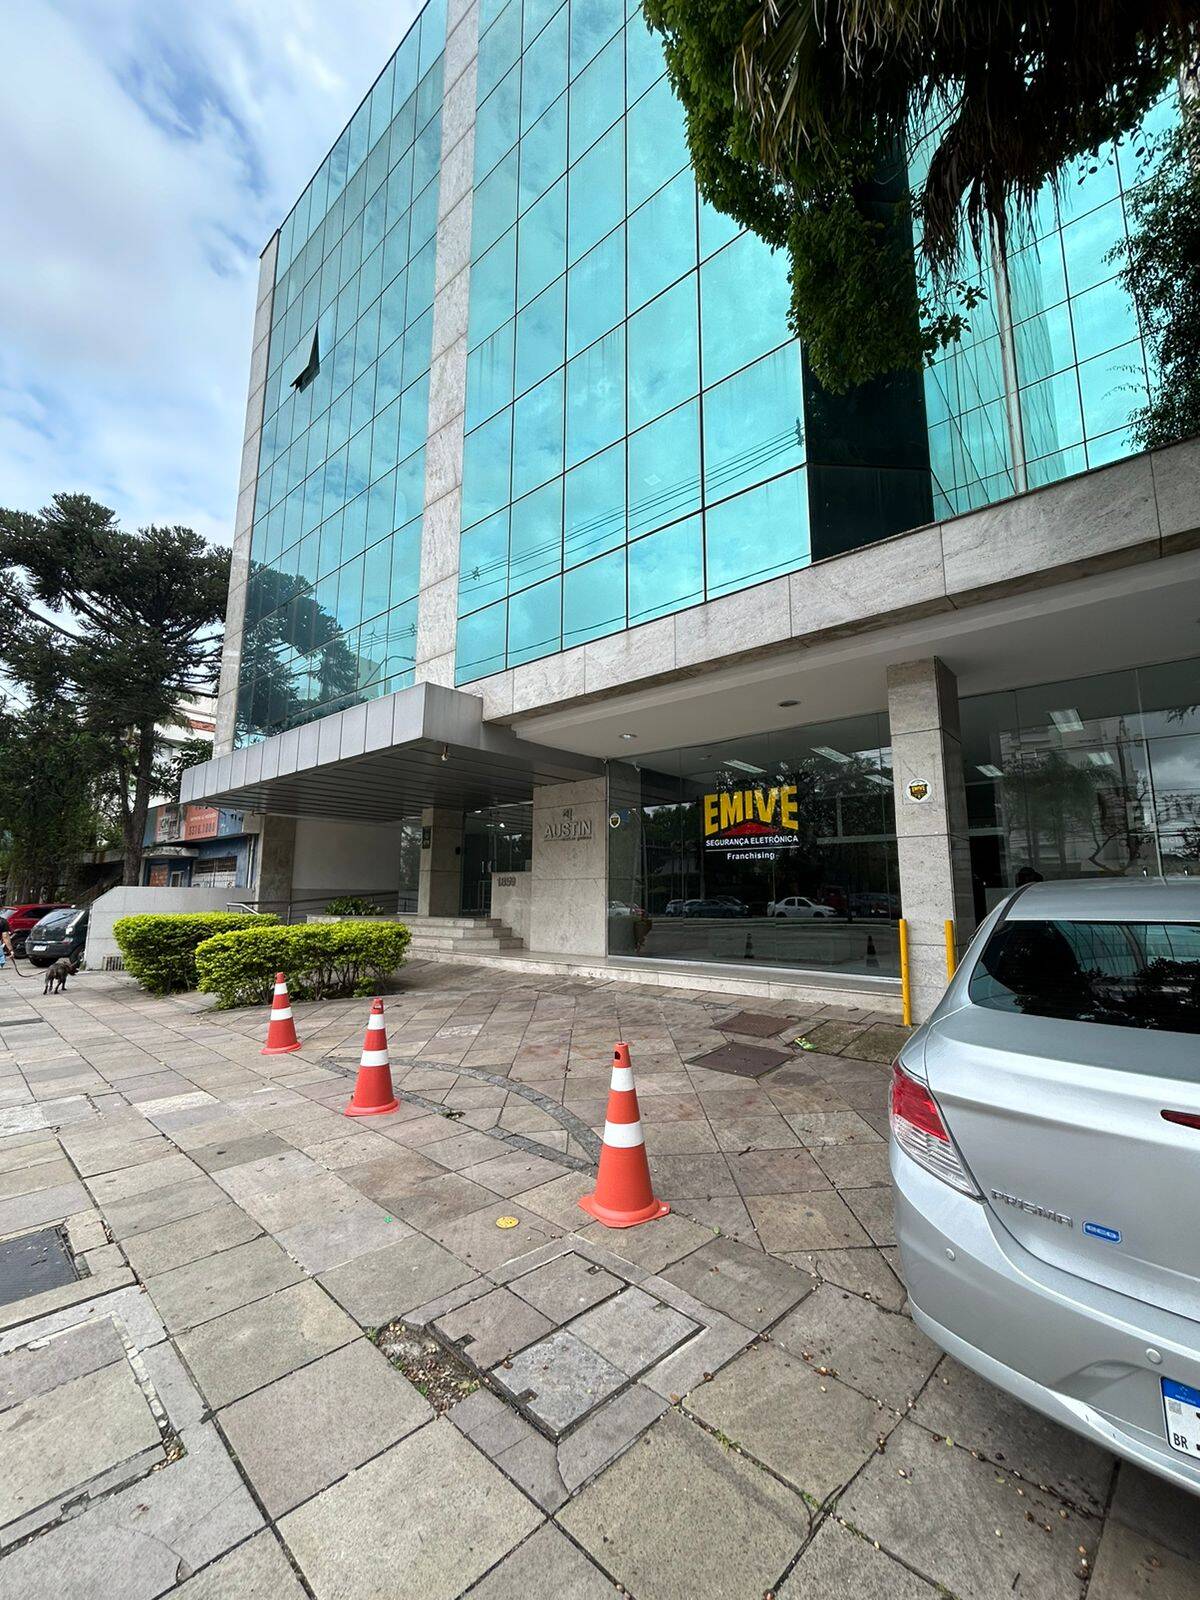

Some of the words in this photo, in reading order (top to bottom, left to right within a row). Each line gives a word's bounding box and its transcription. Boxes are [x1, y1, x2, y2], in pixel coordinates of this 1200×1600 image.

[704, 785, 798, 836] EMIVE
[544, 819, 592, 839] AUSTIN
[706, 838, 750, 847] SEGURANÇA
[750, 834, 799, 845] ELETRÔNICA
[727, 851, 776, 860] Franchising
[991, 1188, 1074, 1228] PRISMA
[1173, 1432, 1189, 1449] BR
